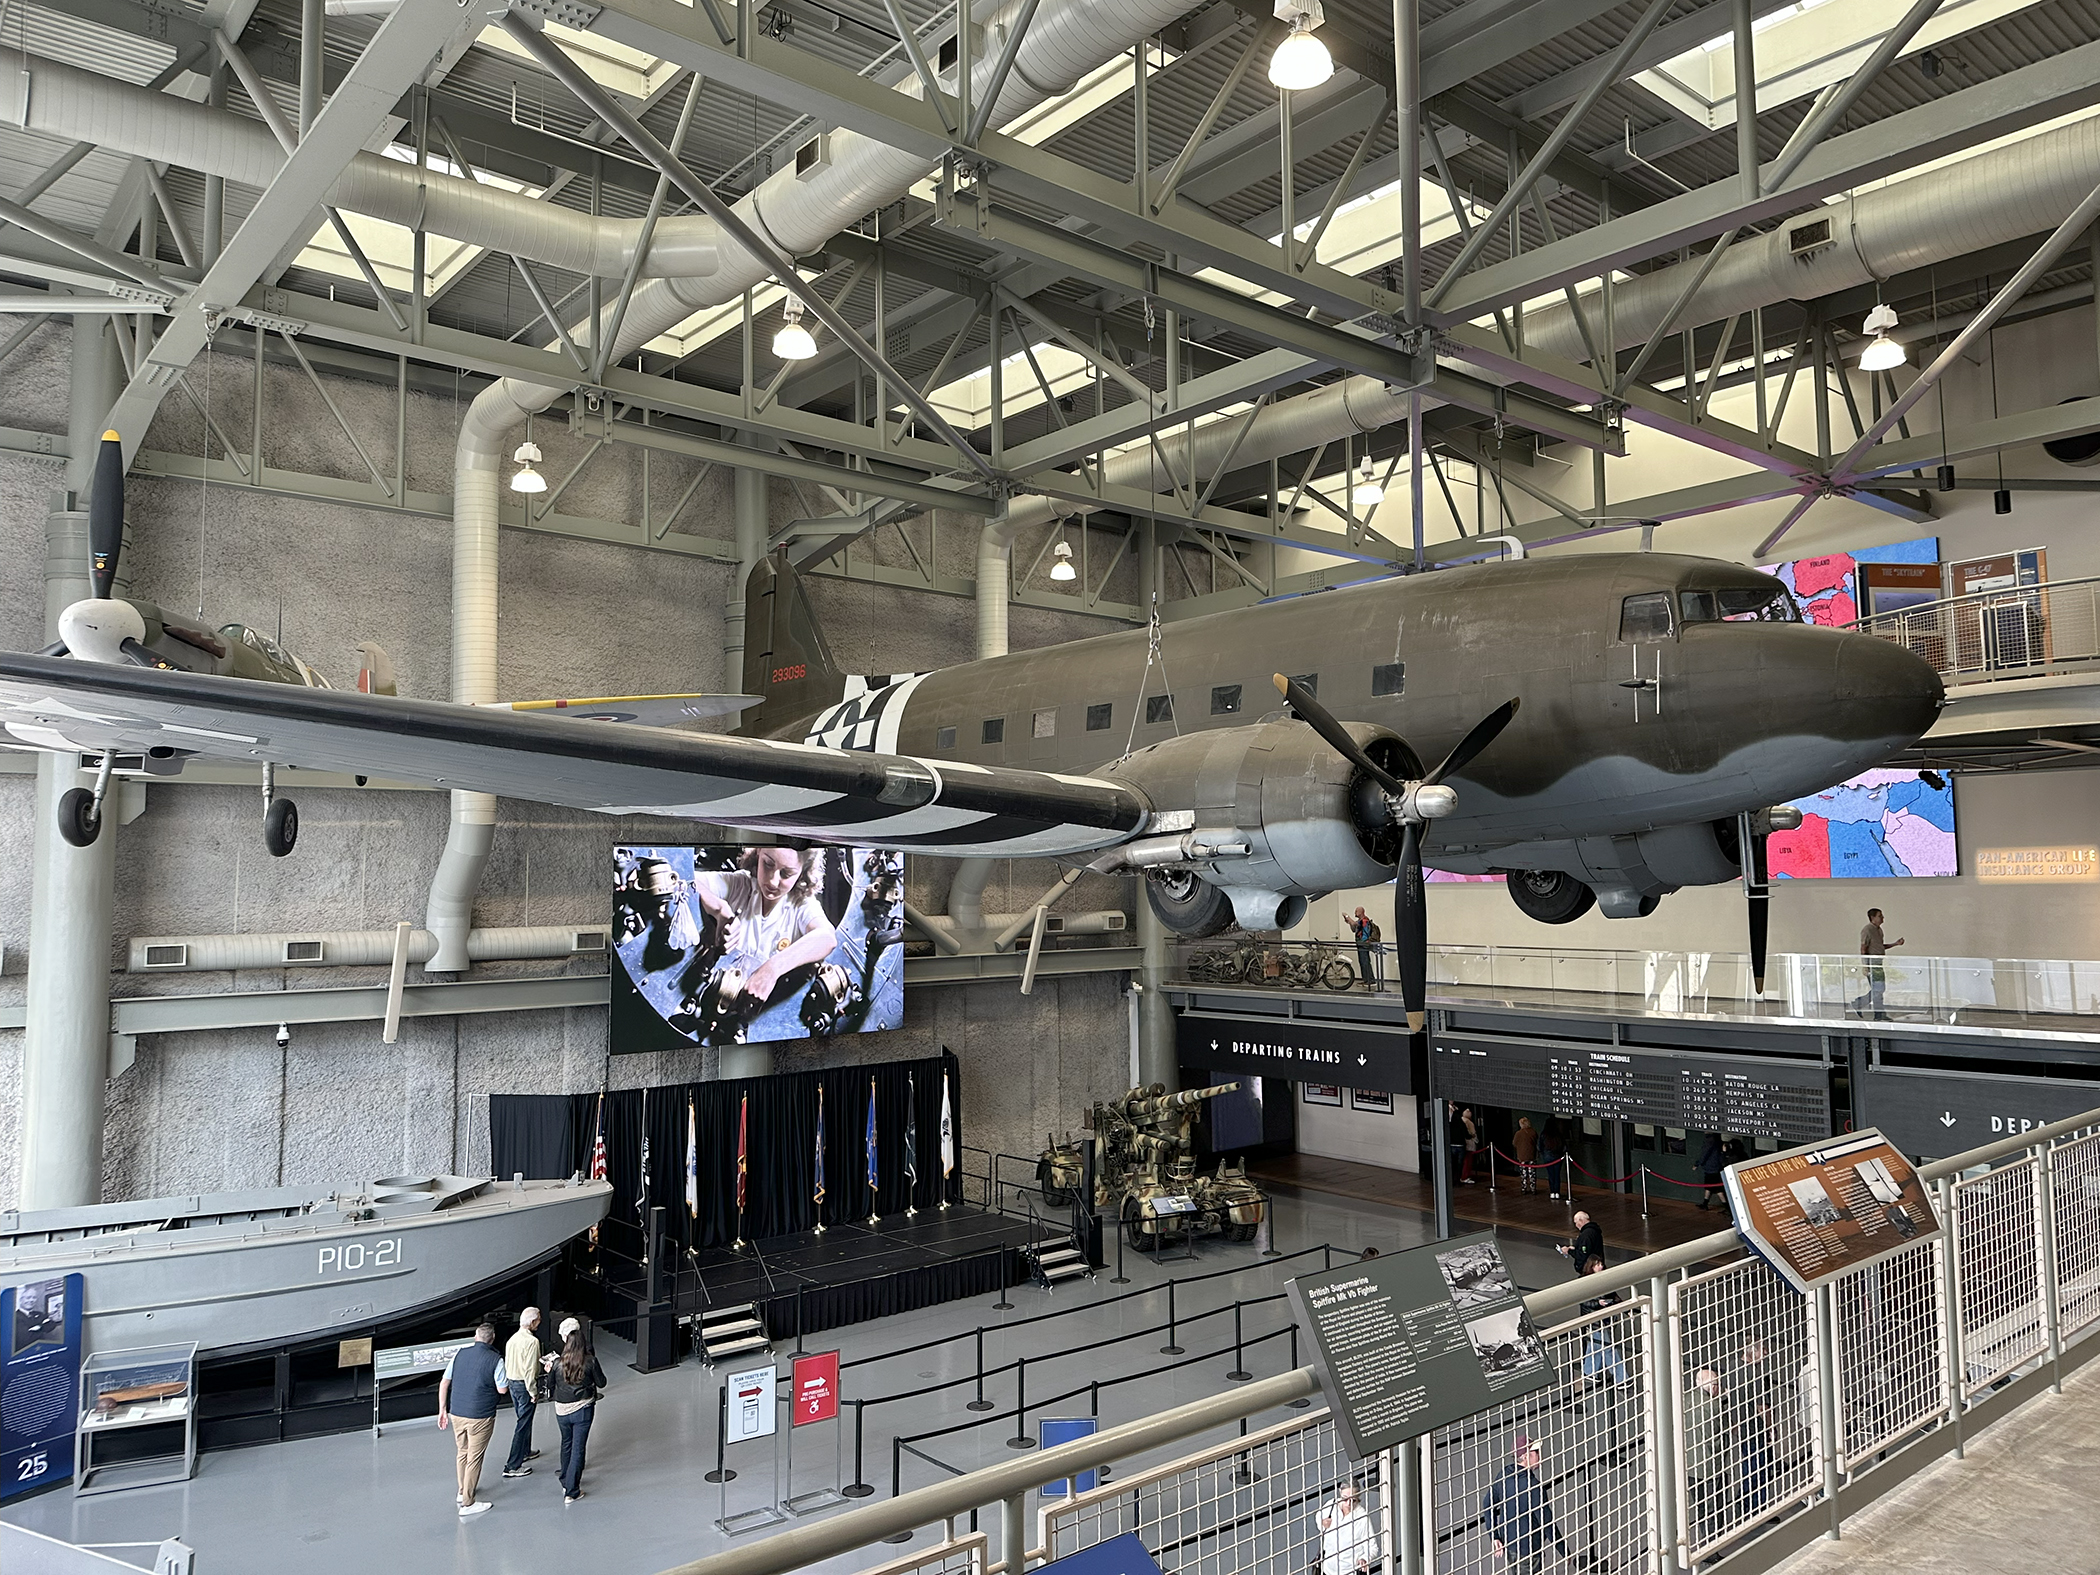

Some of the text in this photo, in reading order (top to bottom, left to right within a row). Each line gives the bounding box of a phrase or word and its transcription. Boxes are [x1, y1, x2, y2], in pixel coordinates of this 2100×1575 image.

[1810, 559, 1830, 568] FINLAND
[1882, 568, 1892, 576] THE
[1964, 567, 1977, 576] THE
[1978, 564, 1992, 573] C-47
[772, 664, 806, 683] 293096
[1978, 850, 2096, 863] PAN-AMERICAN LIFE
[1980, 864, 2090, 876] INSURANCE GROUP
[1233, 1042, 1340, 1063] DEPARTING TRAINS
[1590, 1053, 1630, 1063] TRAIN SCHEDULE
[1590, 1069, 1622, 1077] CINCINNATI
[1590, 1077, 1623, 1085] WASHINGTON
[1727, 1117, 1765, 1126] SHREVEPORT
[1738, 1172, 1755, 1184] THE
[1752, 1167, 1770, 1180] LIFE
[1768, 1163, 1779, 1177] OF
[1779, 1159, 1794, 1173] THE
[1309, 1277, 1369, 1298] British Supermarine
[1313, 1285, 1378, 1309] Spitfire Mk Vb Fighter
[17, 1452, 48, 1481] 25
